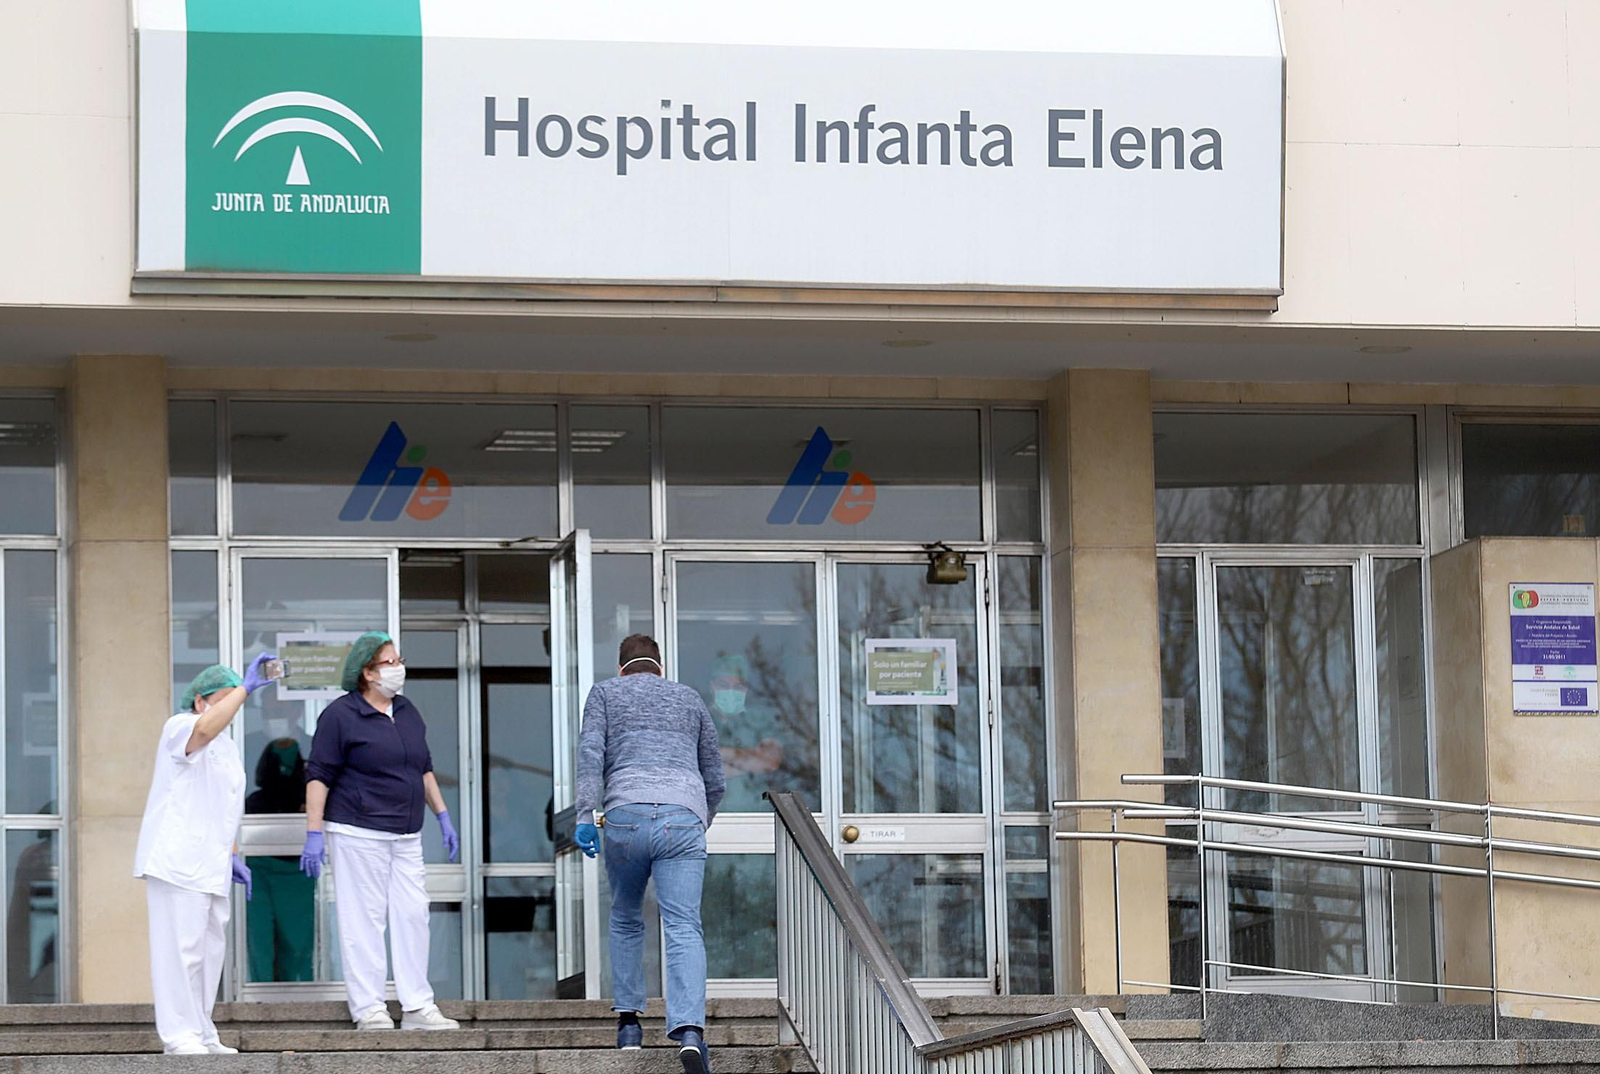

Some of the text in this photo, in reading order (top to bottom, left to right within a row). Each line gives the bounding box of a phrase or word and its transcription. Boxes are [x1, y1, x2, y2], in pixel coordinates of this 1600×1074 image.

[485, 96, 1223, 175] Hospital Infanta Elena
[211, 193, 390, 214] JUNTA DE ANDALUCIA
[873, 661, 889, 669] Solo
[900, 660, 928, 669] familiar
[879, 670, 922, 679] por paciente
